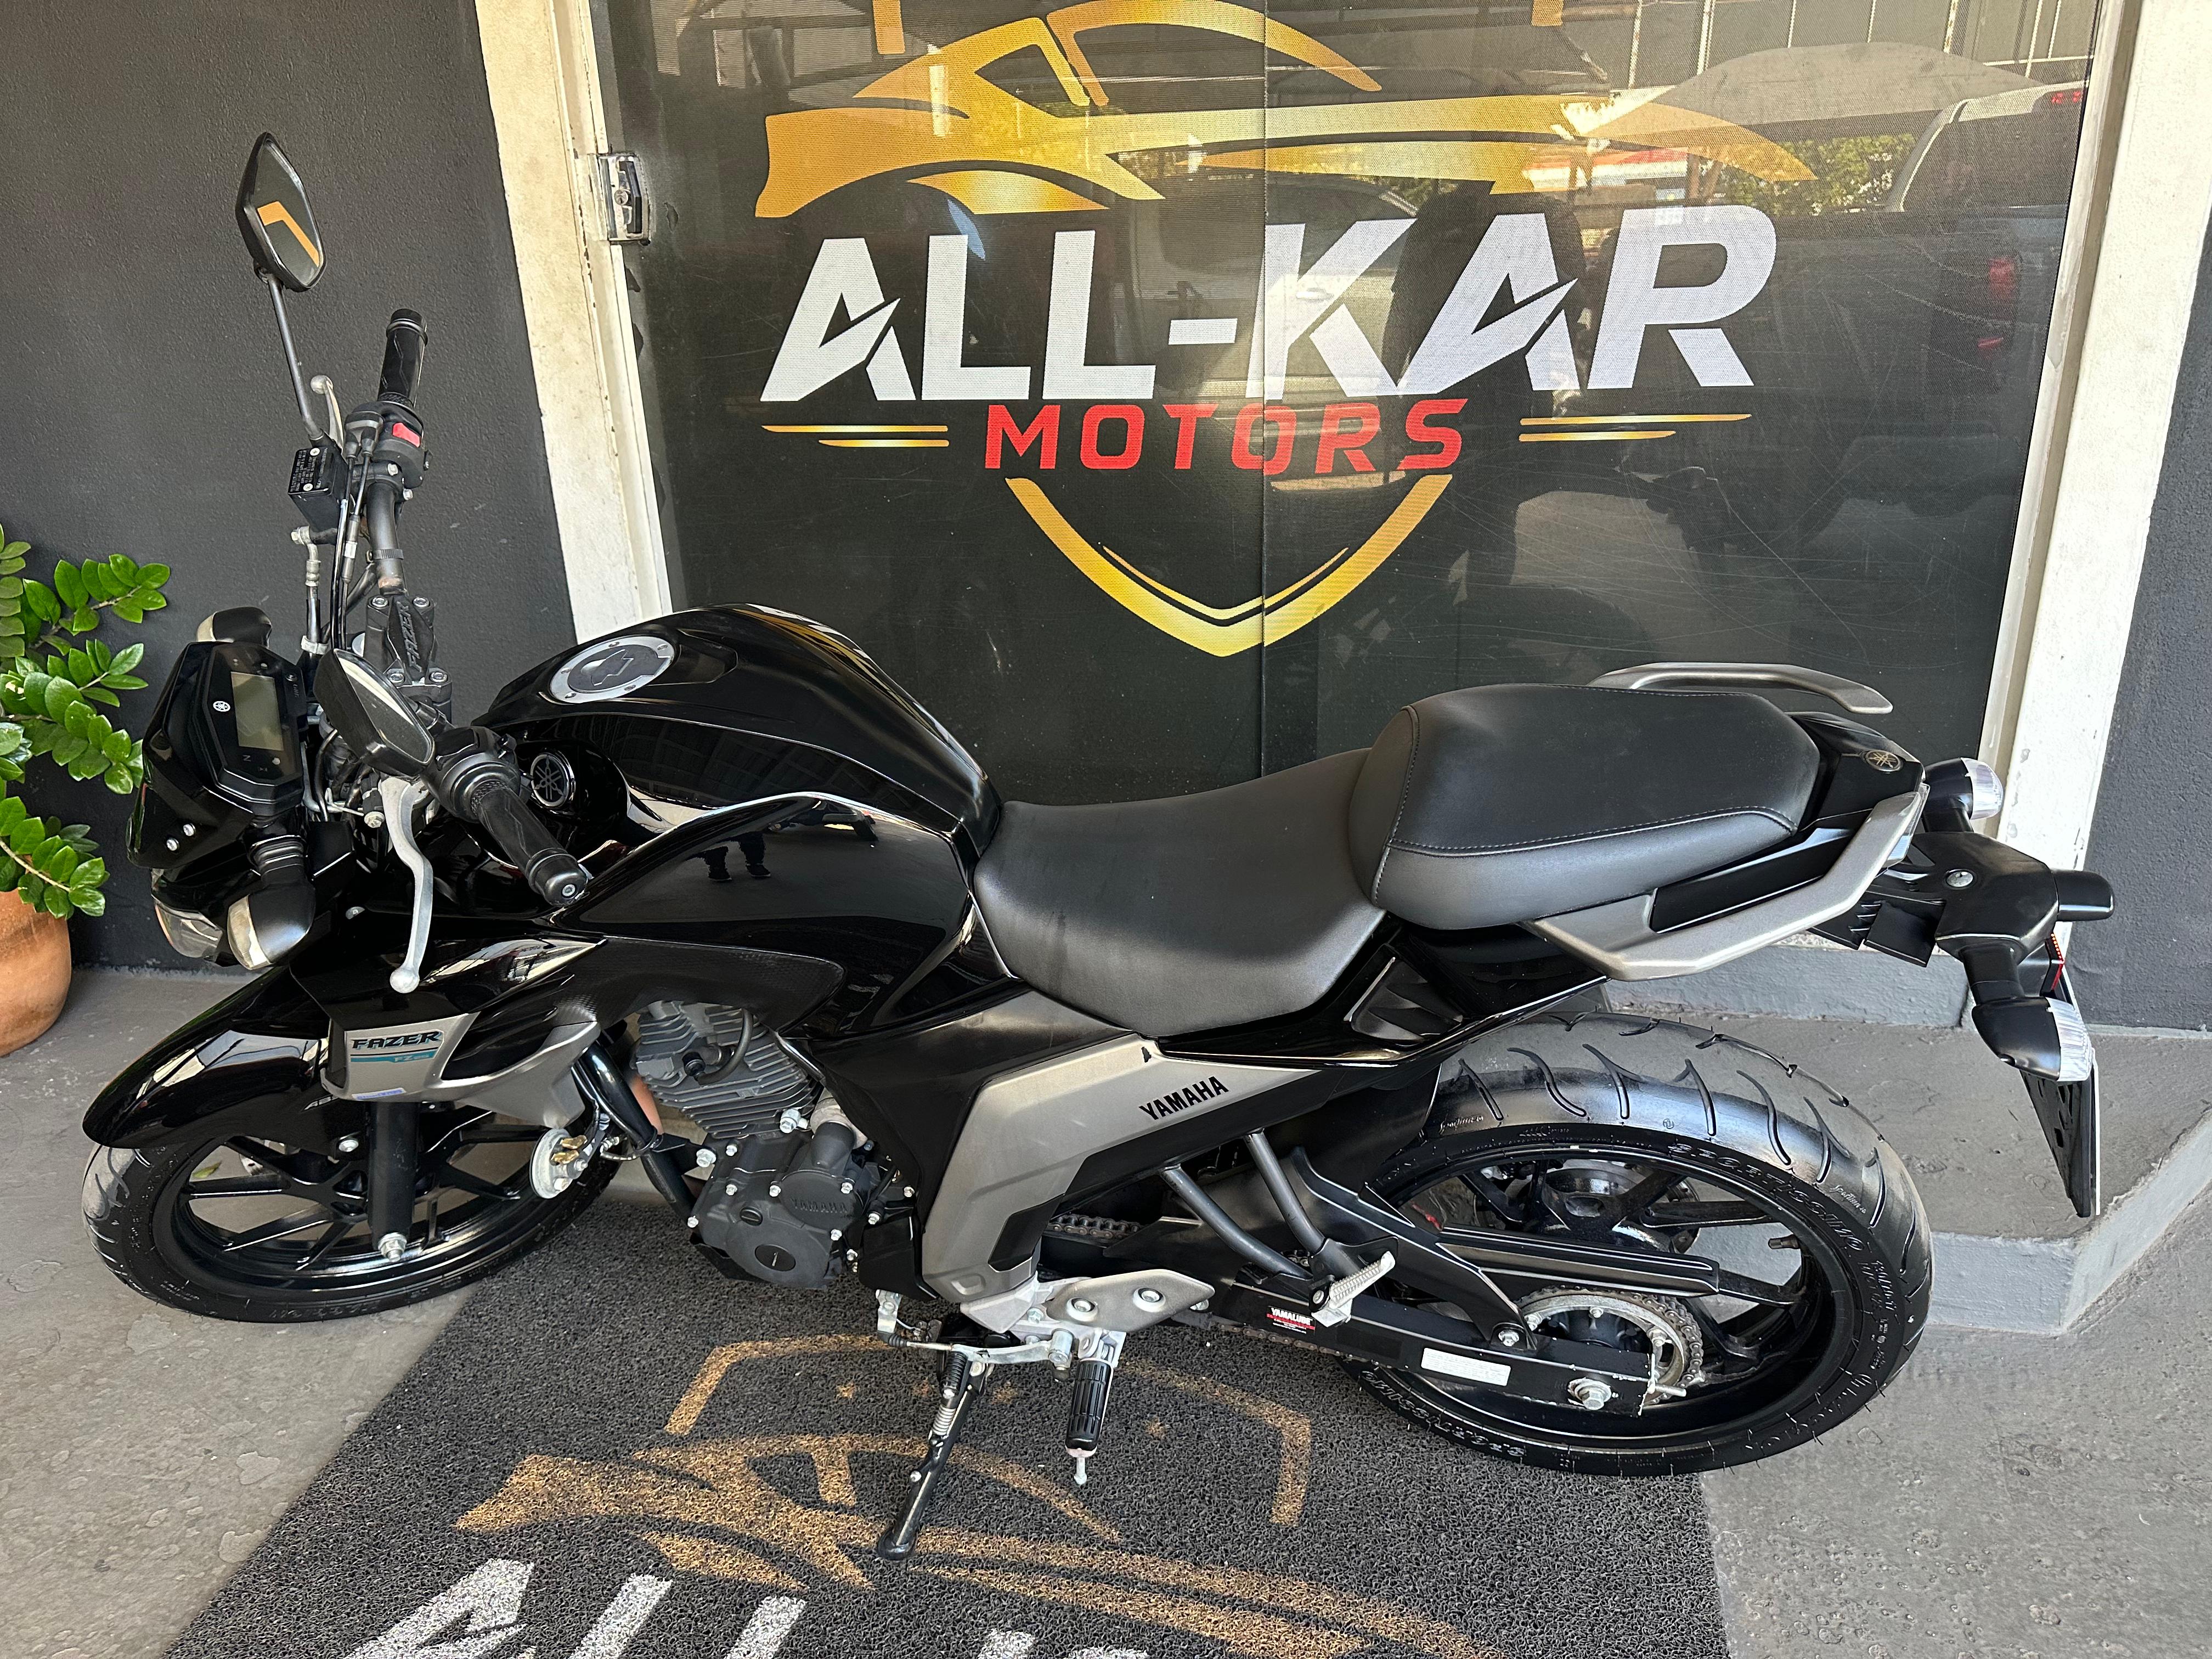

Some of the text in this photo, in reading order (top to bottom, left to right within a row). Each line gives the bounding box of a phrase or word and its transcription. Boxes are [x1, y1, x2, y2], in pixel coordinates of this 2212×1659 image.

[759, 204, 1777, 402] ALL-KAR
[984, 398, 1468, 475] MOTORS
[396, 601, 422, 673] FAZER
[351, 1031, 442, 1050] FAZER
[1138, 1076, 1229, 1120] YAMAHA
[790, 1197, 848, 1214] YAMAHA
[1271, 1307, 1311, 1325] YAMALUBE
